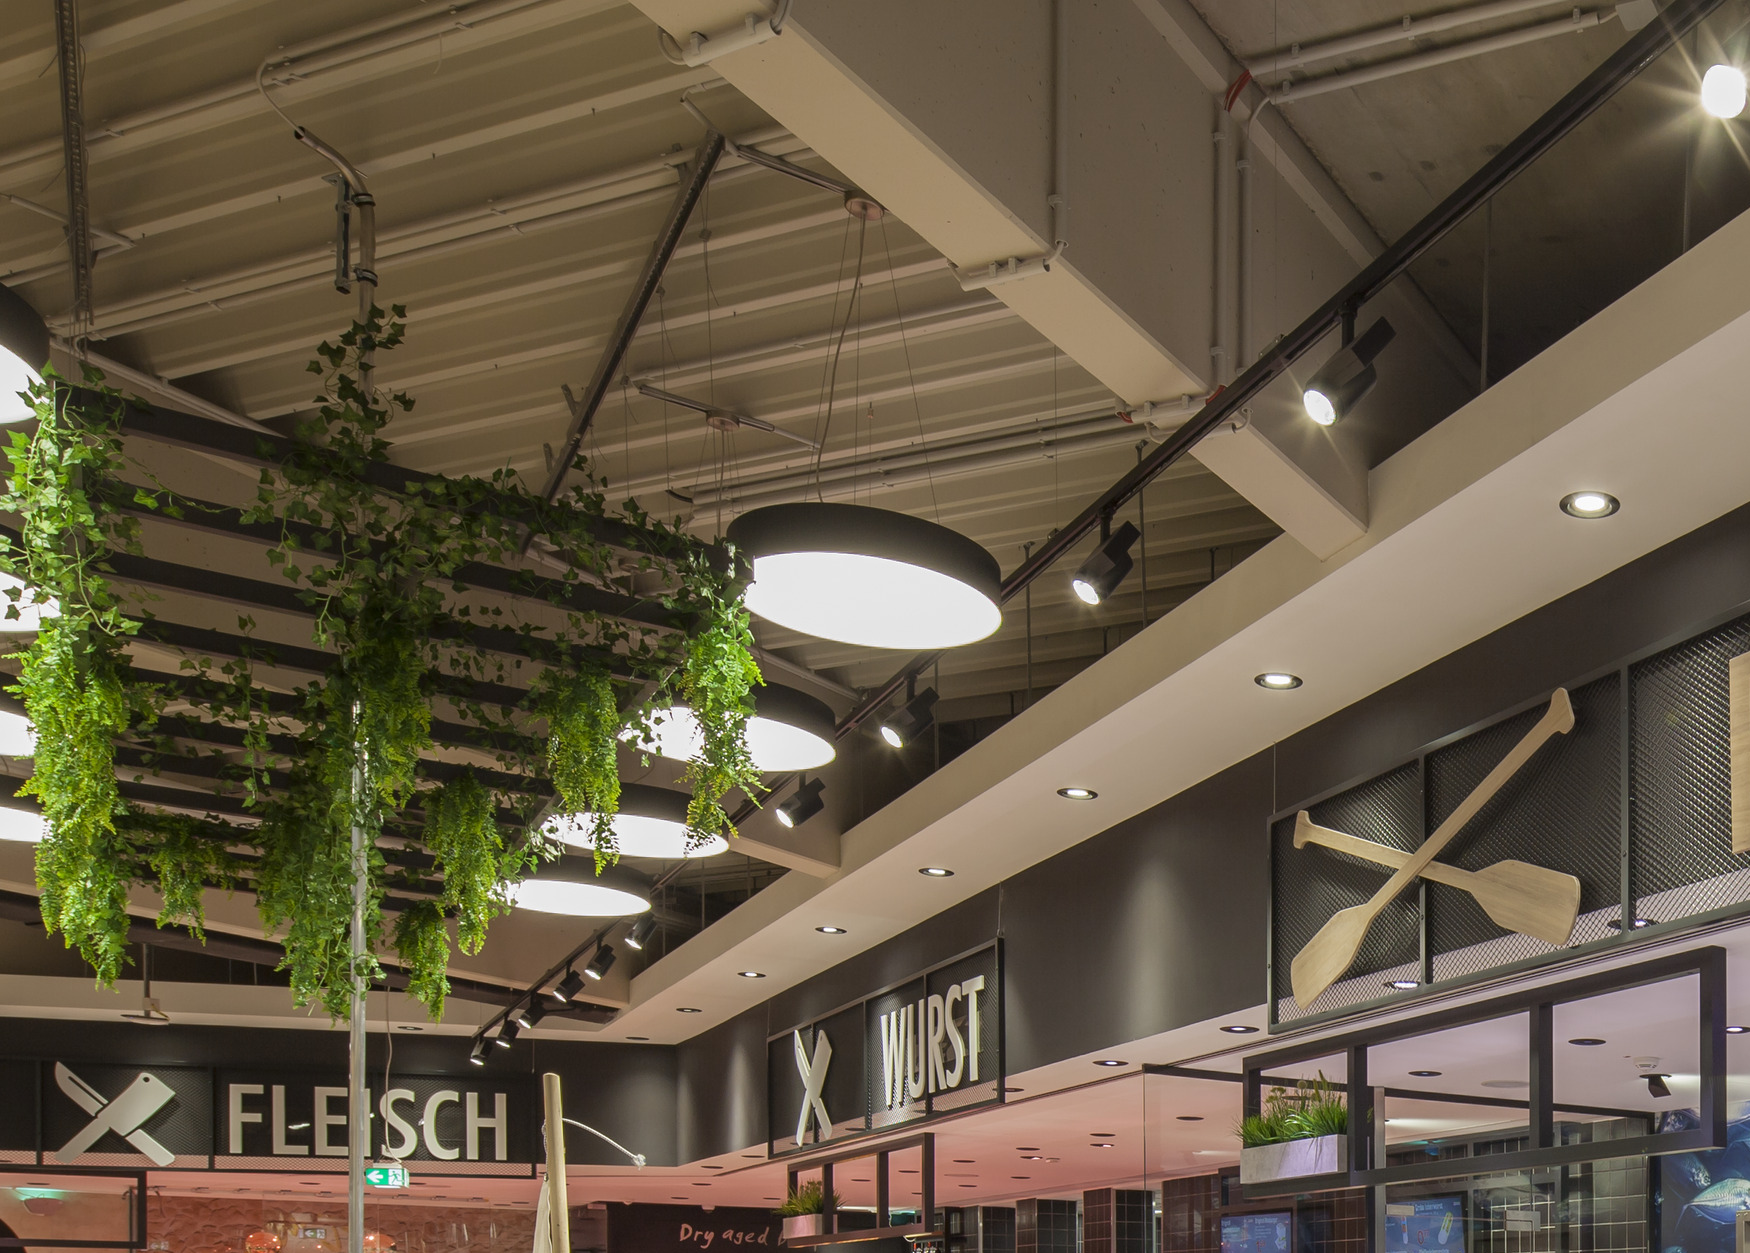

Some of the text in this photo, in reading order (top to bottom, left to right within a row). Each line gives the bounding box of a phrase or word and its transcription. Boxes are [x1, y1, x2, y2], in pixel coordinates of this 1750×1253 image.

[881, 975, 985, 1107] WURST
[229, 1084, 507, 1161] FLEISCH
[679, 1223, 714, 1249] Dry
[722, 1226, 769, 1246] aged
